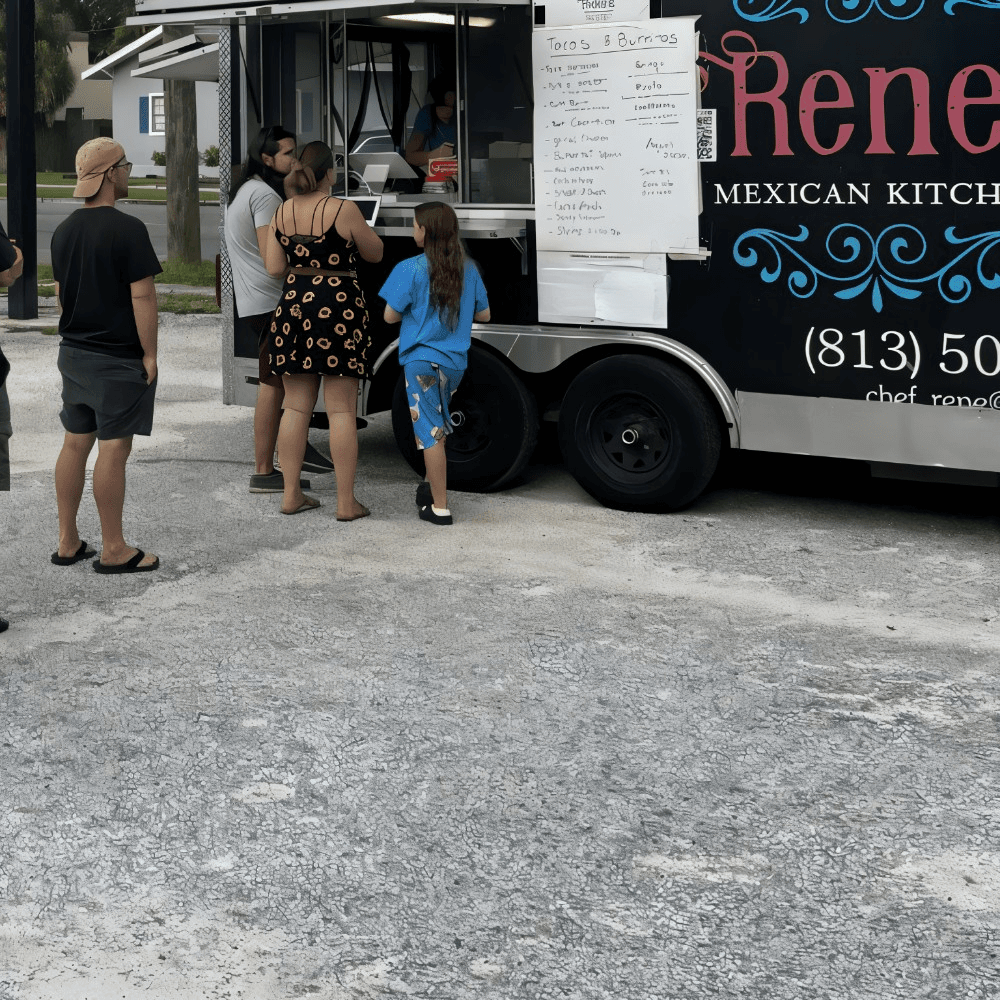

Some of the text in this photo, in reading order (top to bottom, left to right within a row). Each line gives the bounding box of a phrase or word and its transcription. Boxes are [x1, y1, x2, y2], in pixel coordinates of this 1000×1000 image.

[713, 182, 871, 205] MEXICAN
[804, 326, 1000, 380] (813) 50
